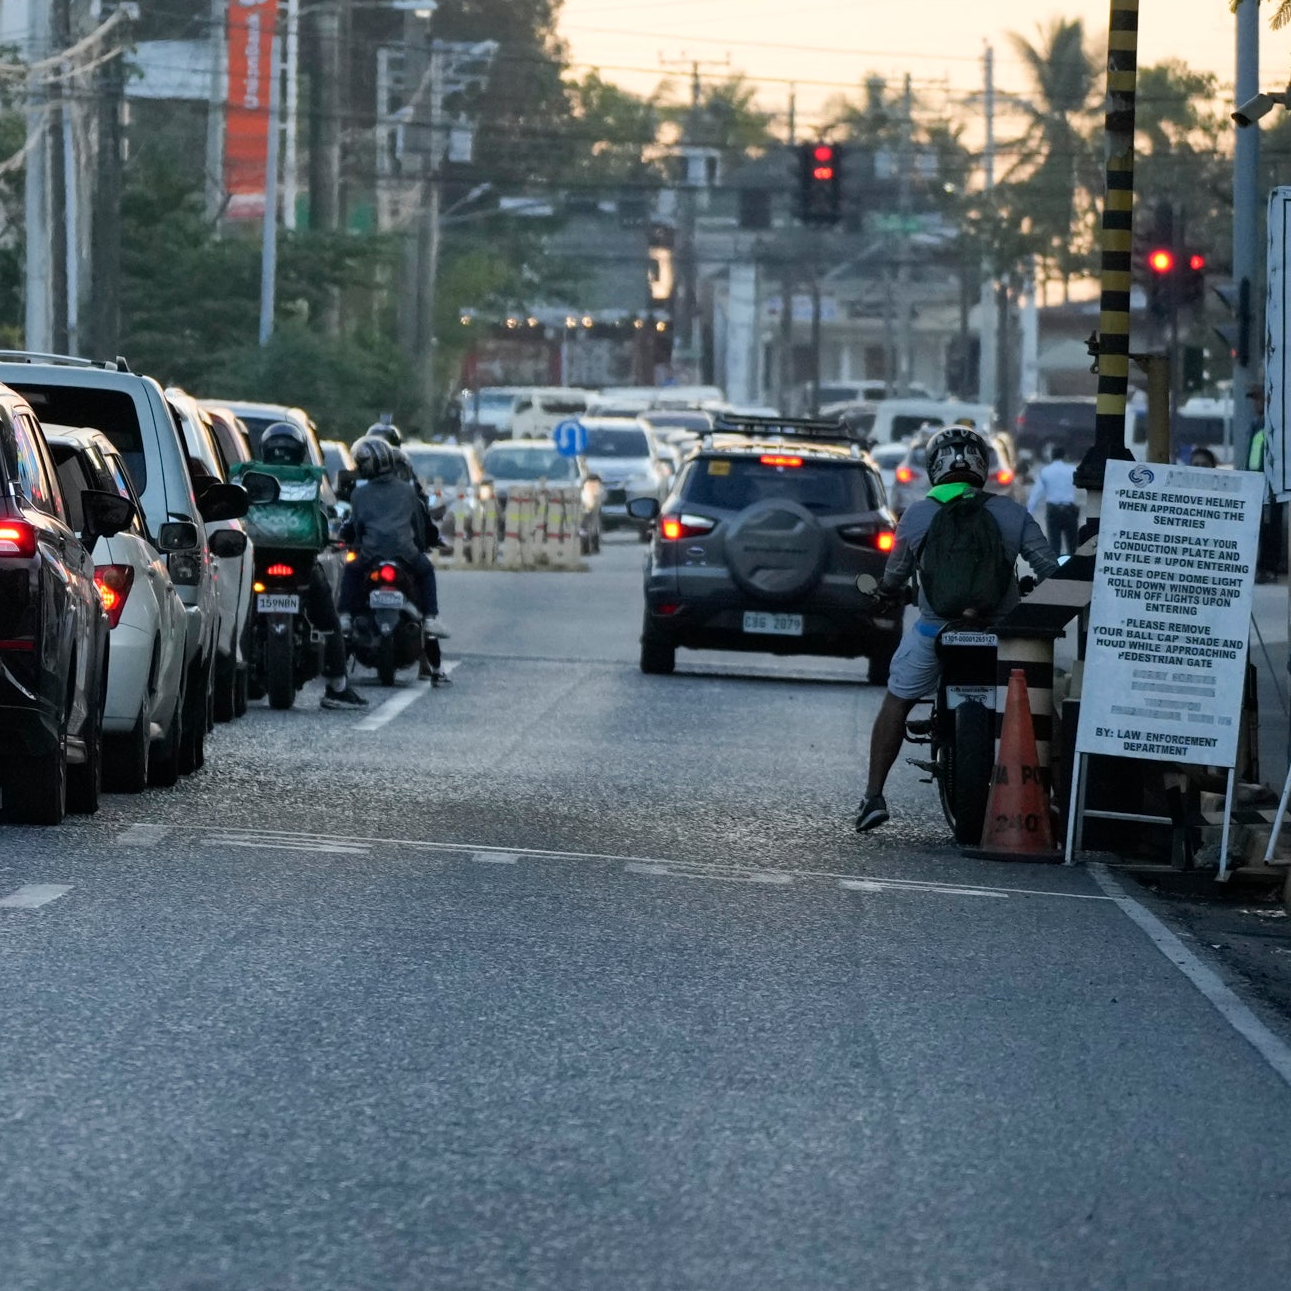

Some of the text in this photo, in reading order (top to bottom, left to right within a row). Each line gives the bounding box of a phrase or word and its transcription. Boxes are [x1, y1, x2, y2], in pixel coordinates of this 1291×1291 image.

[1120, 489, 1246, 509] PLEASE REMOVE HELMET
[1119, 501, 1244, 521] WHEN APPROACHING THE
[1154, 516, 1205, 528] SENTRIES
[1120, 530, 1237, 549] PLEASE DISPLAY YOUR
[1114, 541, 1239, 561] CONDUCTION PLATE AND
[1104, 552, 1248, 574] MV FILE # UPON ENTERING
[1104, 566, 1243, 587] PLEASE OPEN DOME LIGHT
[1108, 578, 1240, 598] ROLL DOWN WINDOWS AND
[1115, 589, 1231, 607] TURN OFF LIGHTS UPON
[1146, 603, 1197, 615] ENTERING
[1127, 619, 1211, 635] PLEASE REMOVE
[1093, 626, 1243, 649] YOUR BALL CAP SHADE AND
[1129, 641, 1161, 652] WHILE
[1166, 644, 1236, 659] APPROACHING
[1118, 652, 1212, 668] PEDESTRIAN GATE
[1096, 728, 1218, 747] BY: LAW ENFORCEMENT
[1124, 742, 1188, 756] DEPARTMENT
